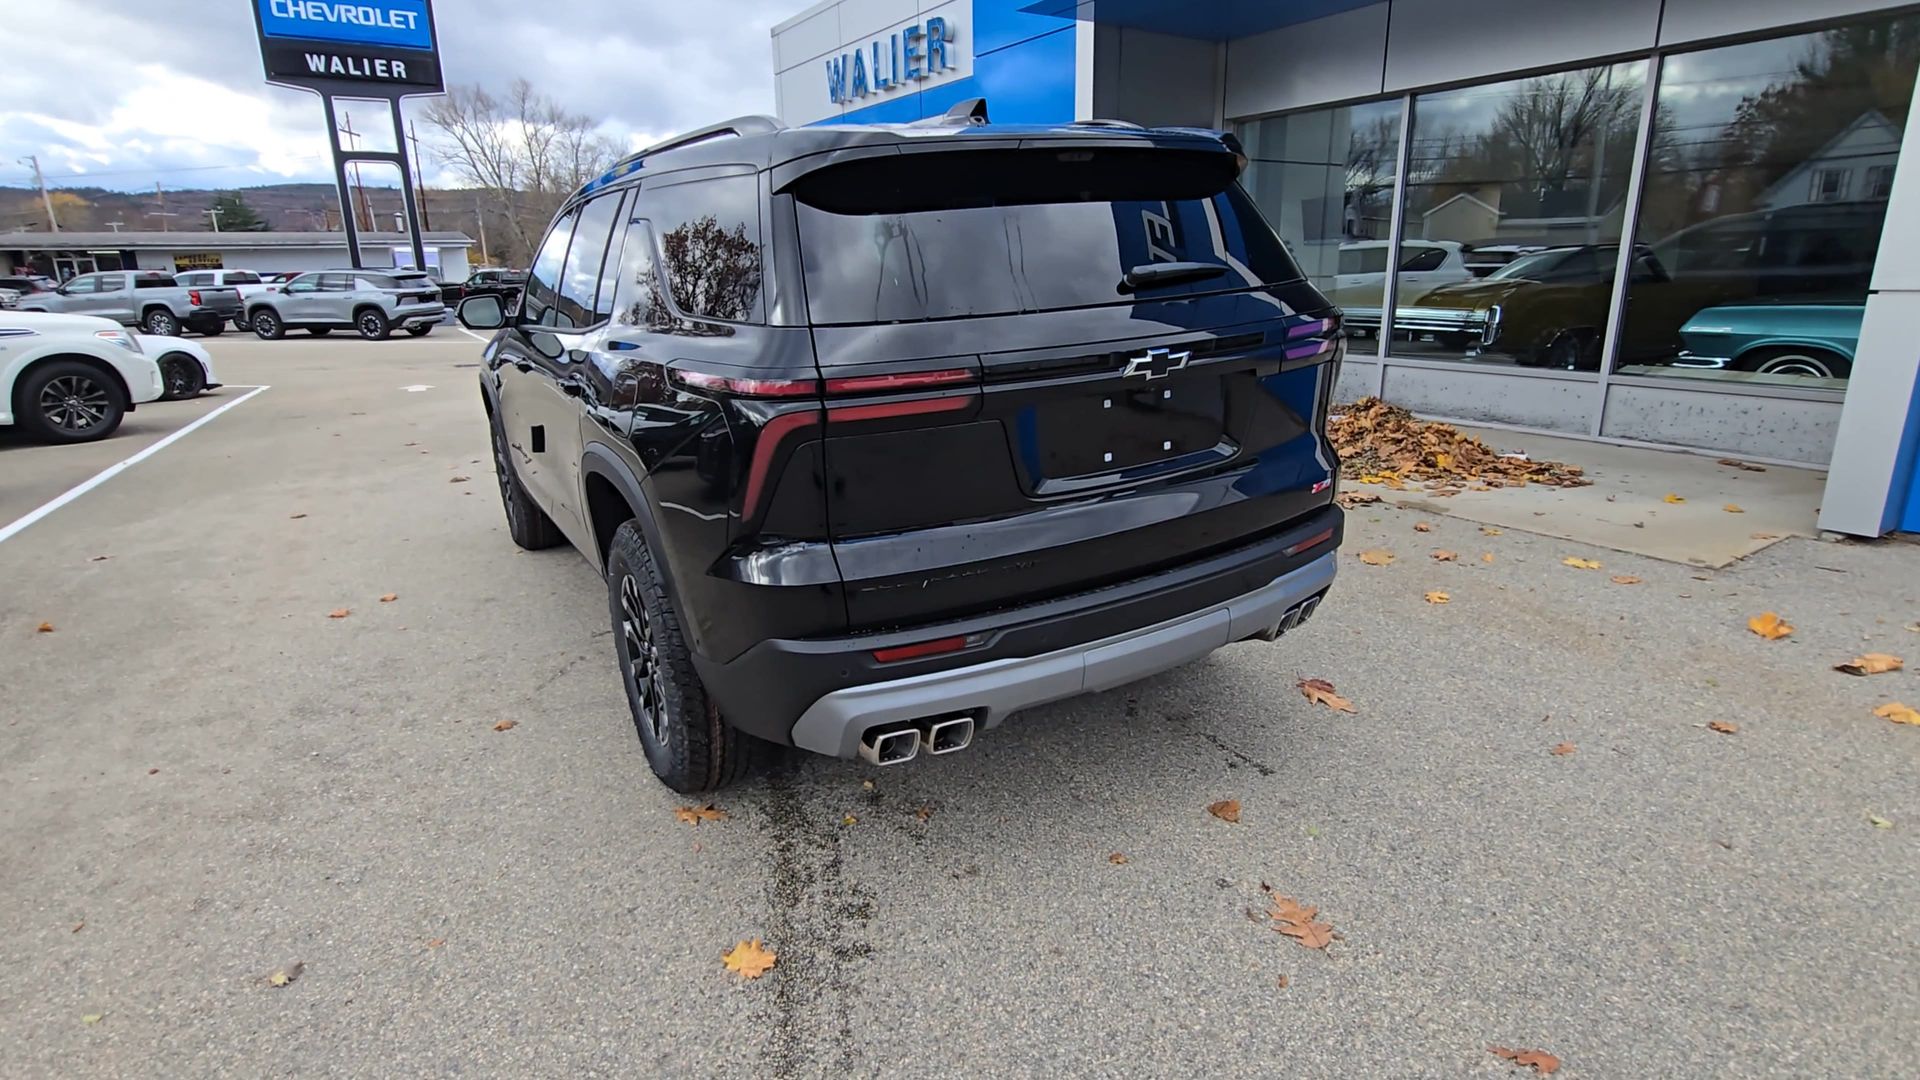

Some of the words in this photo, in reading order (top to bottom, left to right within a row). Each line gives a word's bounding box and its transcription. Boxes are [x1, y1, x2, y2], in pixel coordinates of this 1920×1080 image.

[269, 0, 418, 30] CHEVROLET
[305, 53, 407, 79] WALIER
[826, 16, 954, 104] WALIER
